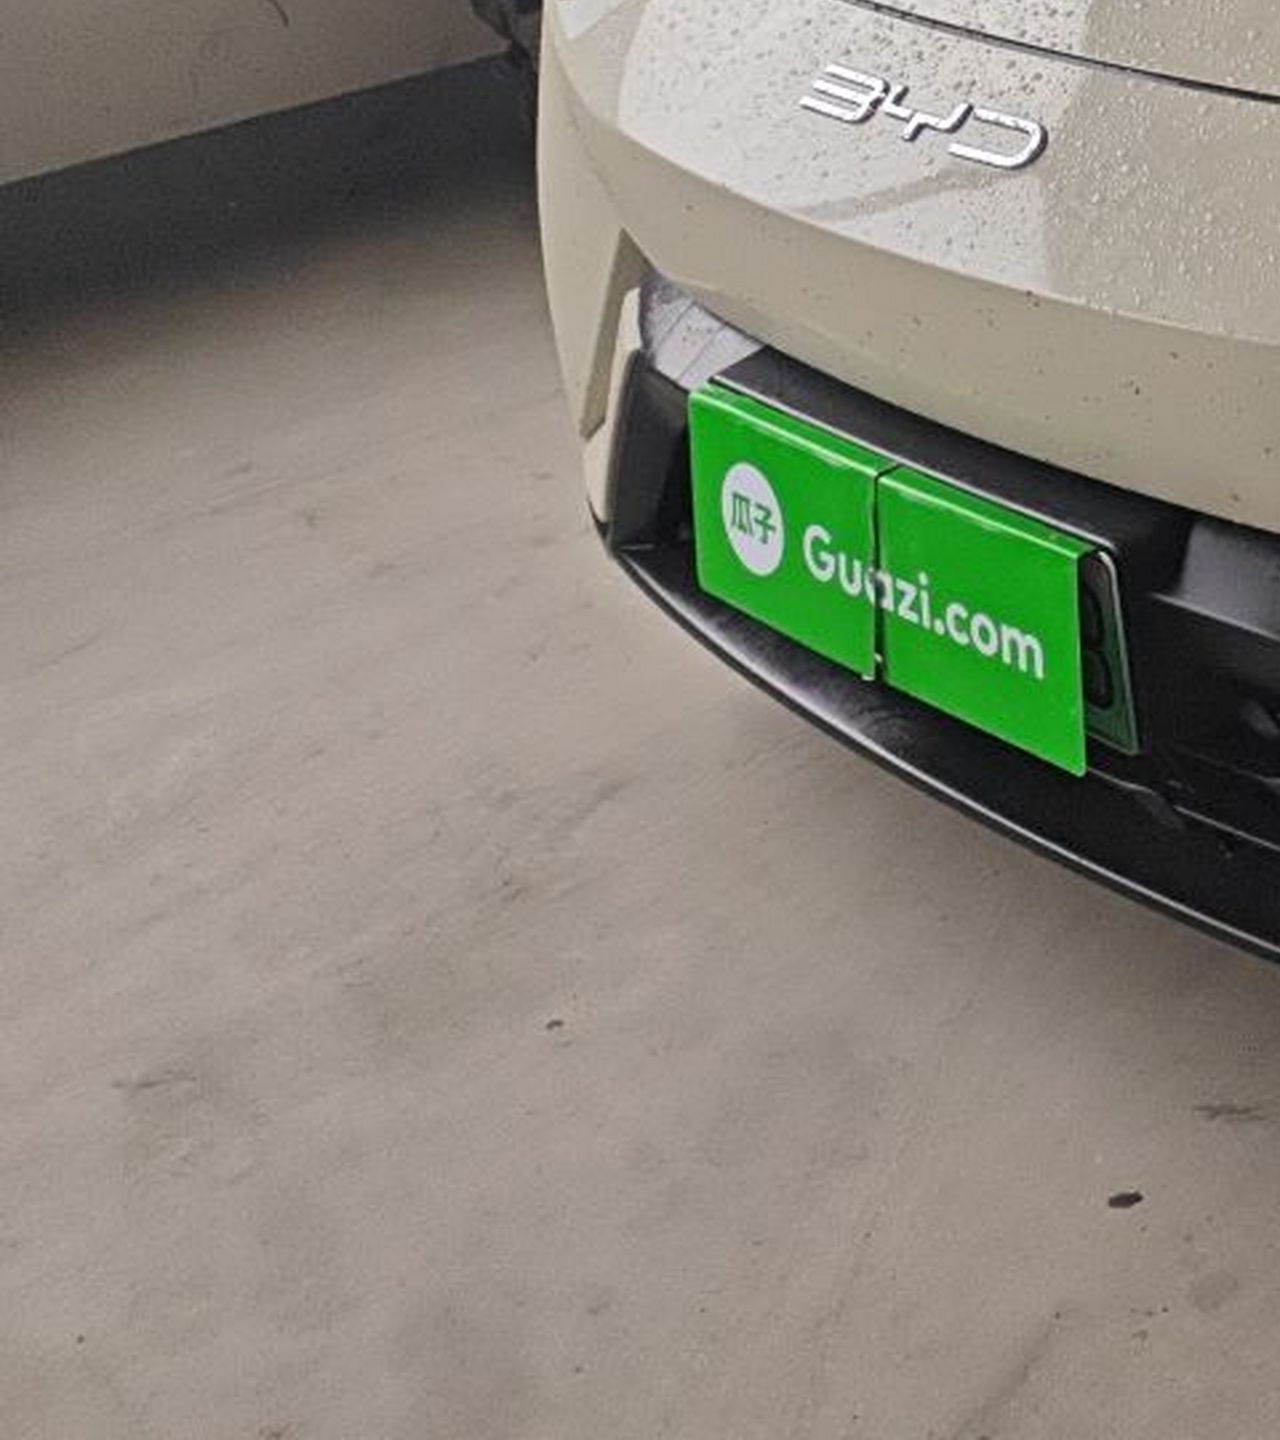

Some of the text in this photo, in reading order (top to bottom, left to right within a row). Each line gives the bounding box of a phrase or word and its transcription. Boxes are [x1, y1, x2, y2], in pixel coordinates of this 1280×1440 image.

[800, 63, 1048, 170] BYD
[731, 491, 777, 545] 瓜子
[803, 524, 1045, 680] Guazi.com
